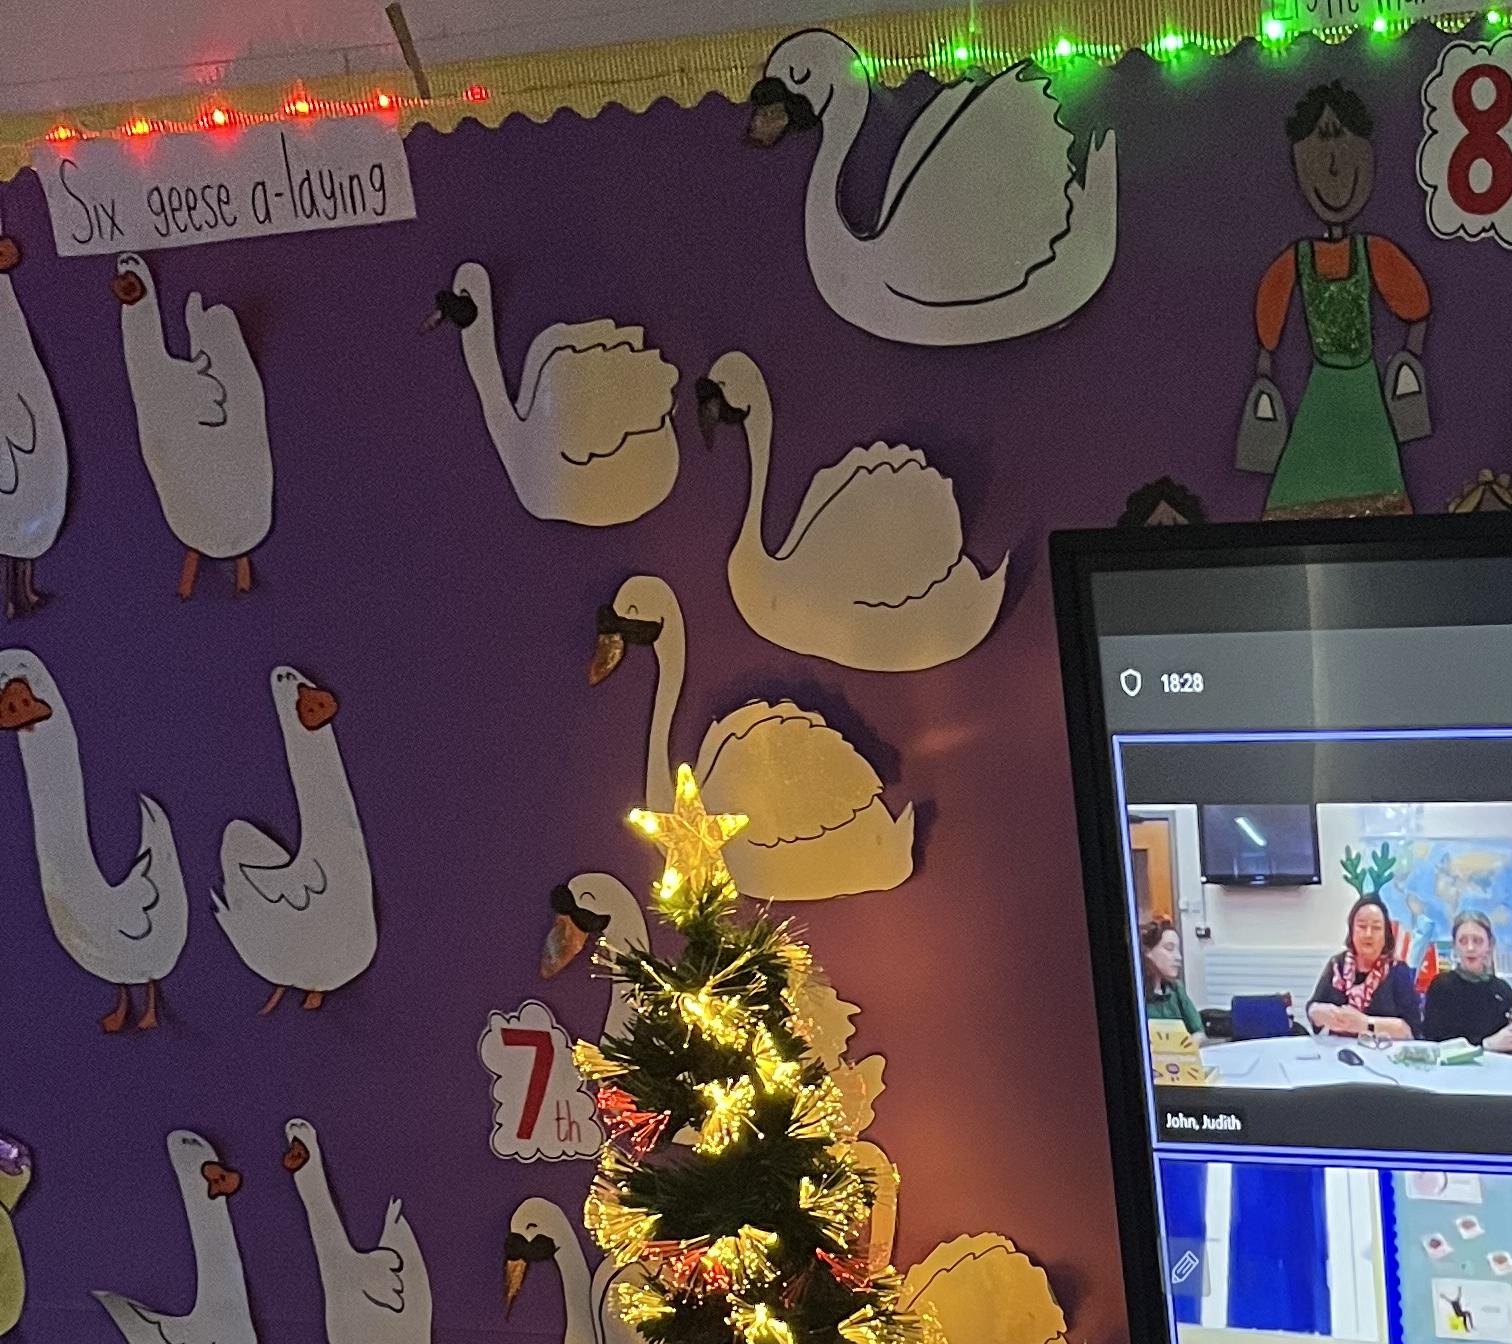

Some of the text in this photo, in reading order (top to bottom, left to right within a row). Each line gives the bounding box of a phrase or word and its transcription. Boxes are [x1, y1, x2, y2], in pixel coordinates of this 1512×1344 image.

[59, 132, 386, 244] Six geese a-laying
[1160, 672, 1204, 693] 18:28
[501, 1027, 582, 1143] 7th
[1166, 1112, 1241, 1131] John, Judith
